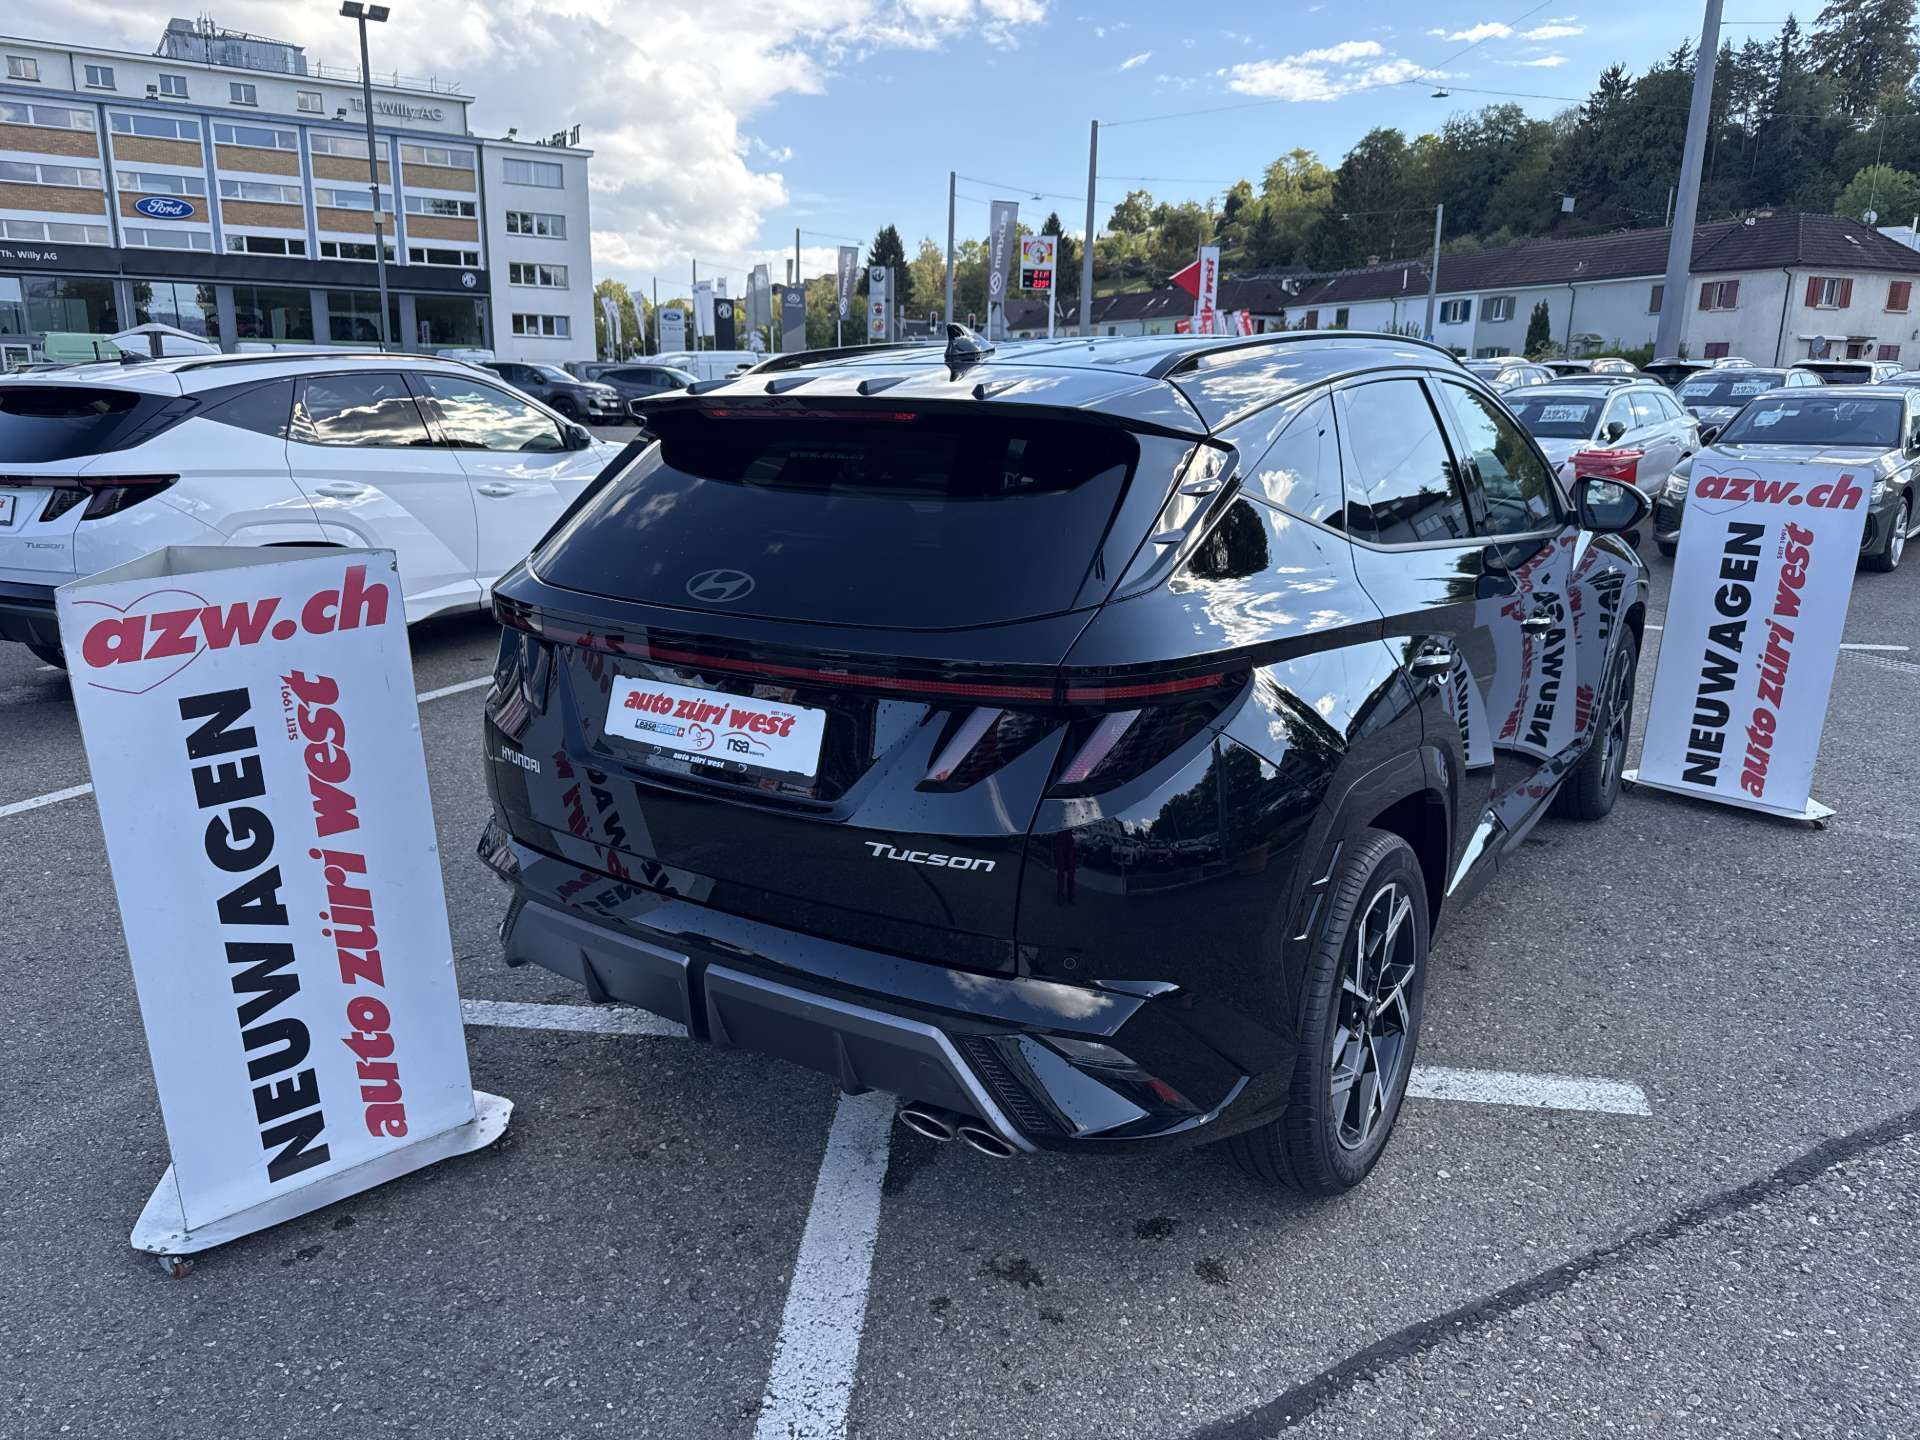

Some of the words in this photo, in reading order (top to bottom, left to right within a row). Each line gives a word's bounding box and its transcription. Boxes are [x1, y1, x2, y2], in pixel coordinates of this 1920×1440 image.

[381, 102, 416, 120] Willy
[421, 107, 444, 121] AG
[147, 199, 183, 215] Ford
[1745, 217, 1756, 226] 48
[0, 250, 16, 258] Th.
[17, 250, 41, 261] Willy
[44, 252, 58, 260] AG
[1695, 473, 1863, 511] azw.ch
[1773, 521, 1815, 618] west
[82, 564, 390, 669] azw.ch
[1681, 521, 1766, 788] NEUWAGEN
[1756, 617, 1795, 710] züri
[280, 685, 294, 713] 1991
[624, 690, 675, 715] auto
[673, 697, 730, 726] züri
[729, 708, 796, 737] west
[286, 717, 298, 741] SEIT
[726, 738, 750, 754] nsa
[280, 669, 361, 838] west
[501, 745, 542, 775] HYUNDAI
[672, 752, 690, 761] auto
[707, 759, 725, 769] west
[1740, 707, 1777, 799] auto
[178, 687, 331, 1184] NEUWAGEN
[308, 848, 387, 988] züri
[341, 995, 408, 1138] auto
